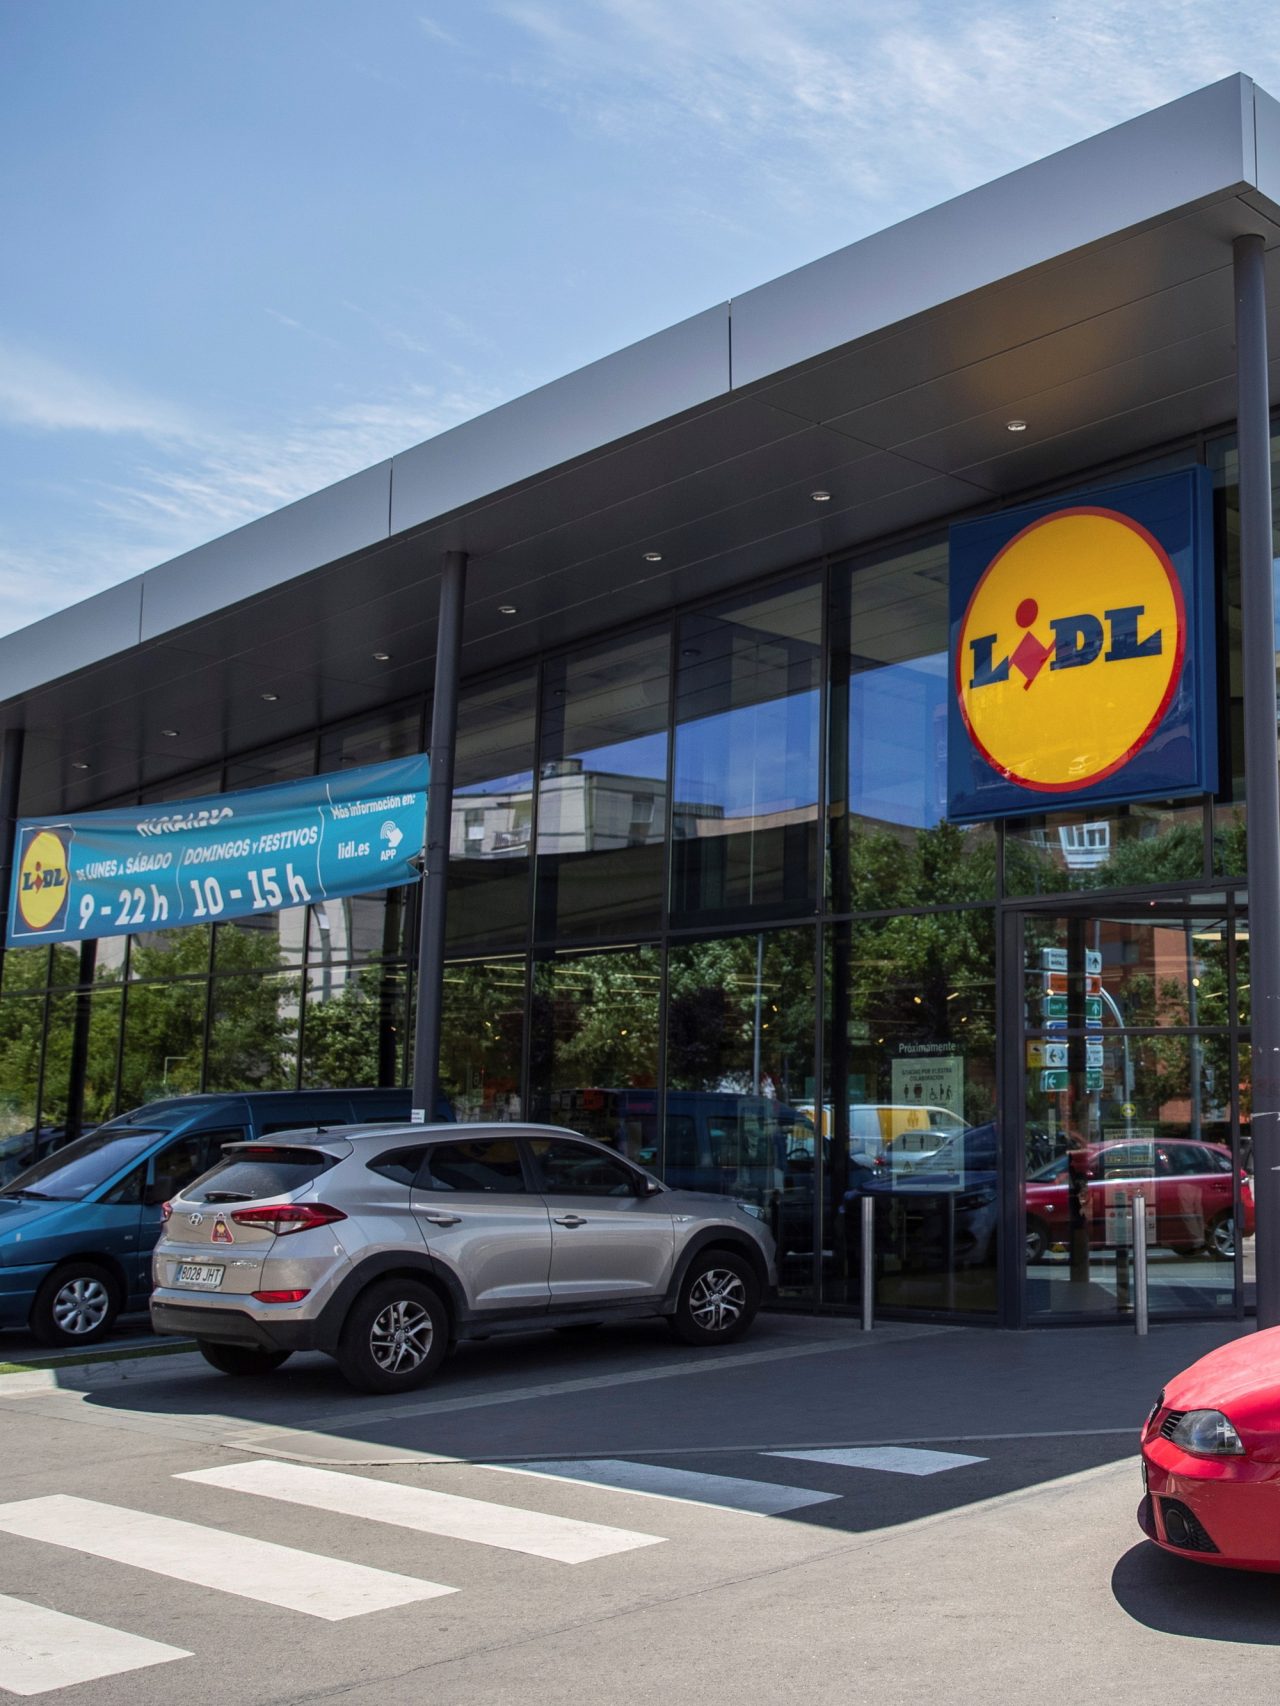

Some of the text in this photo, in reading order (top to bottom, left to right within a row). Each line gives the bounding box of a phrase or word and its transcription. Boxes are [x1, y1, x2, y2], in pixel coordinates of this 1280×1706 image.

[331, 793, 416, 820] Más información en:
[183, 825, 318, 865] DOMINGOS Y FESTIVOS
[337, 840, 370, 860] lidl.es
[380, 848, 397, 862] APP
[76, 852, 173, 881] DE LUNES A SÁBADO
[190, 876, 224, 918] 10
[247, 867, 283, 909] 15
[286, 863, 312, 904] h
[79, 893, 95, 930] 9
[114, 887, 147, 926] 22
[150, 883, 168, 922] h
[899, 1041, 957, 1053] Próximamente
[202, 1268, 221, 1283] JHT
